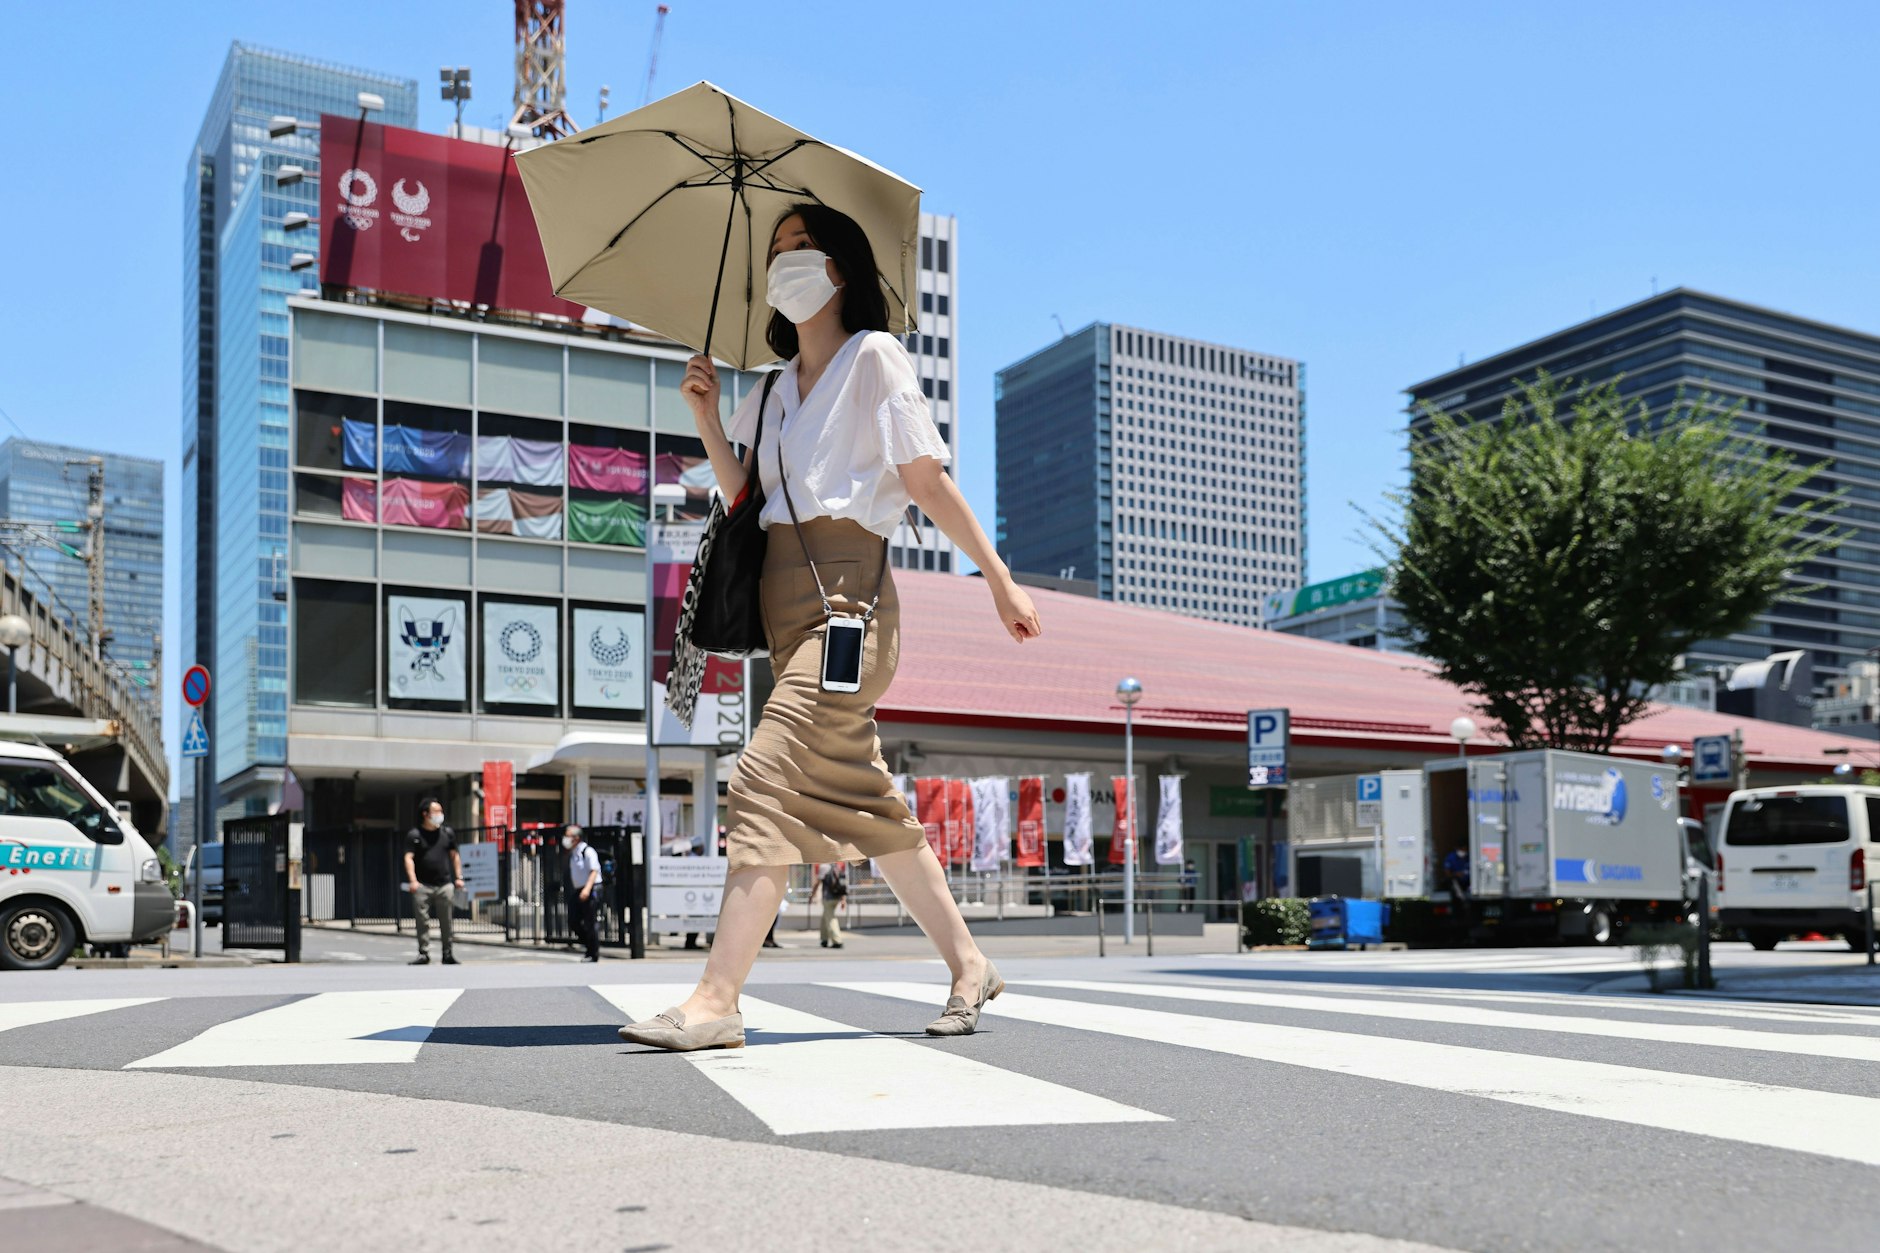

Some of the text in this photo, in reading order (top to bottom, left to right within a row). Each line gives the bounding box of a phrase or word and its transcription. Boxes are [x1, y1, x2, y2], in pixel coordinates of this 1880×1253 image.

[498, 665, 545, 676] TOKYO 2020
[588, 668, 633, 678] TOKYO 2020
[1255, 715, 1277, 744] P
[1363, 780, 1379, 800] P
[1553, 781, 1613, 813] HYBRID
[9, 846, 93, 867] Enefit
